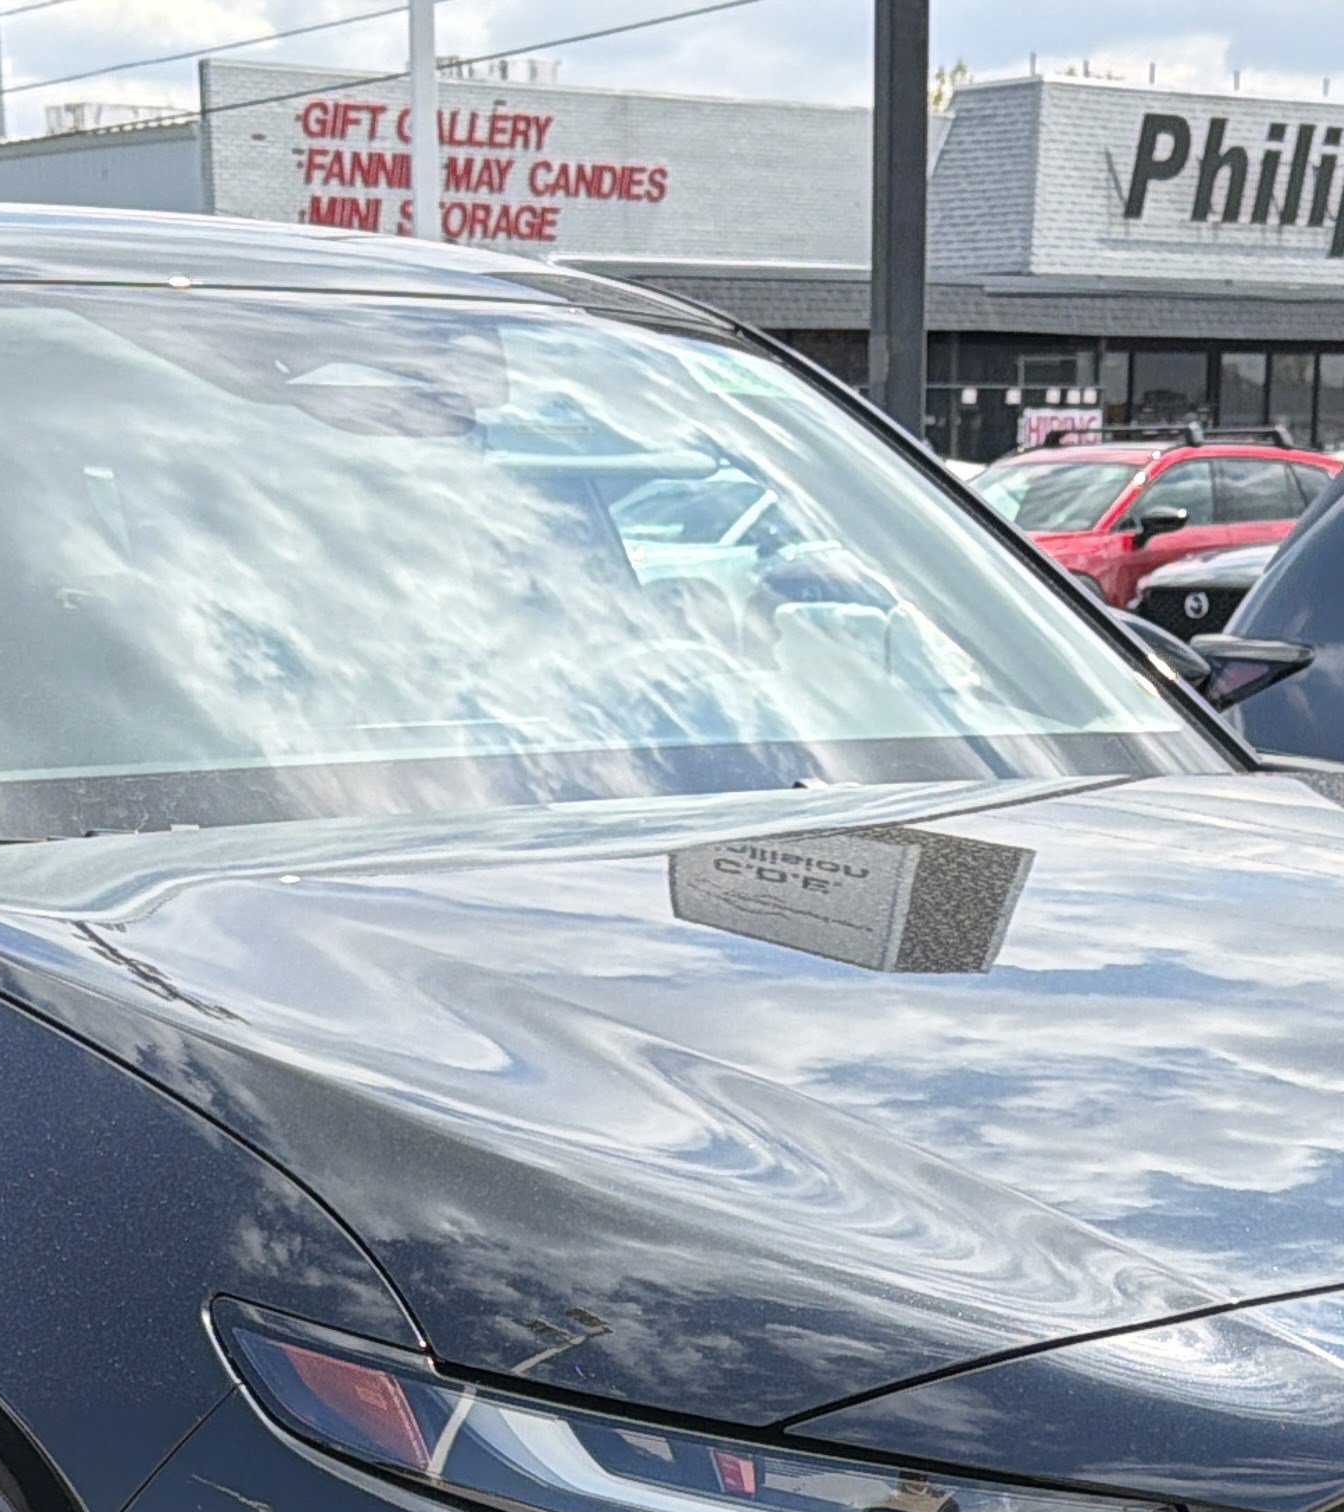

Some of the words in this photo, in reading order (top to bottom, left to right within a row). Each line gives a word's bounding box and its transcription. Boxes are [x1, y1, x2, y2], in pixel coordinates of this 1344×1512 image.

[302, 101, 388, 140] GIFT
[304, 148, 412, 189] FANNI
[445, 156, 515, 194] MAY
[528, 160, 668, 204] CANDIES
[396, 199, 561, 242] SORAGE
